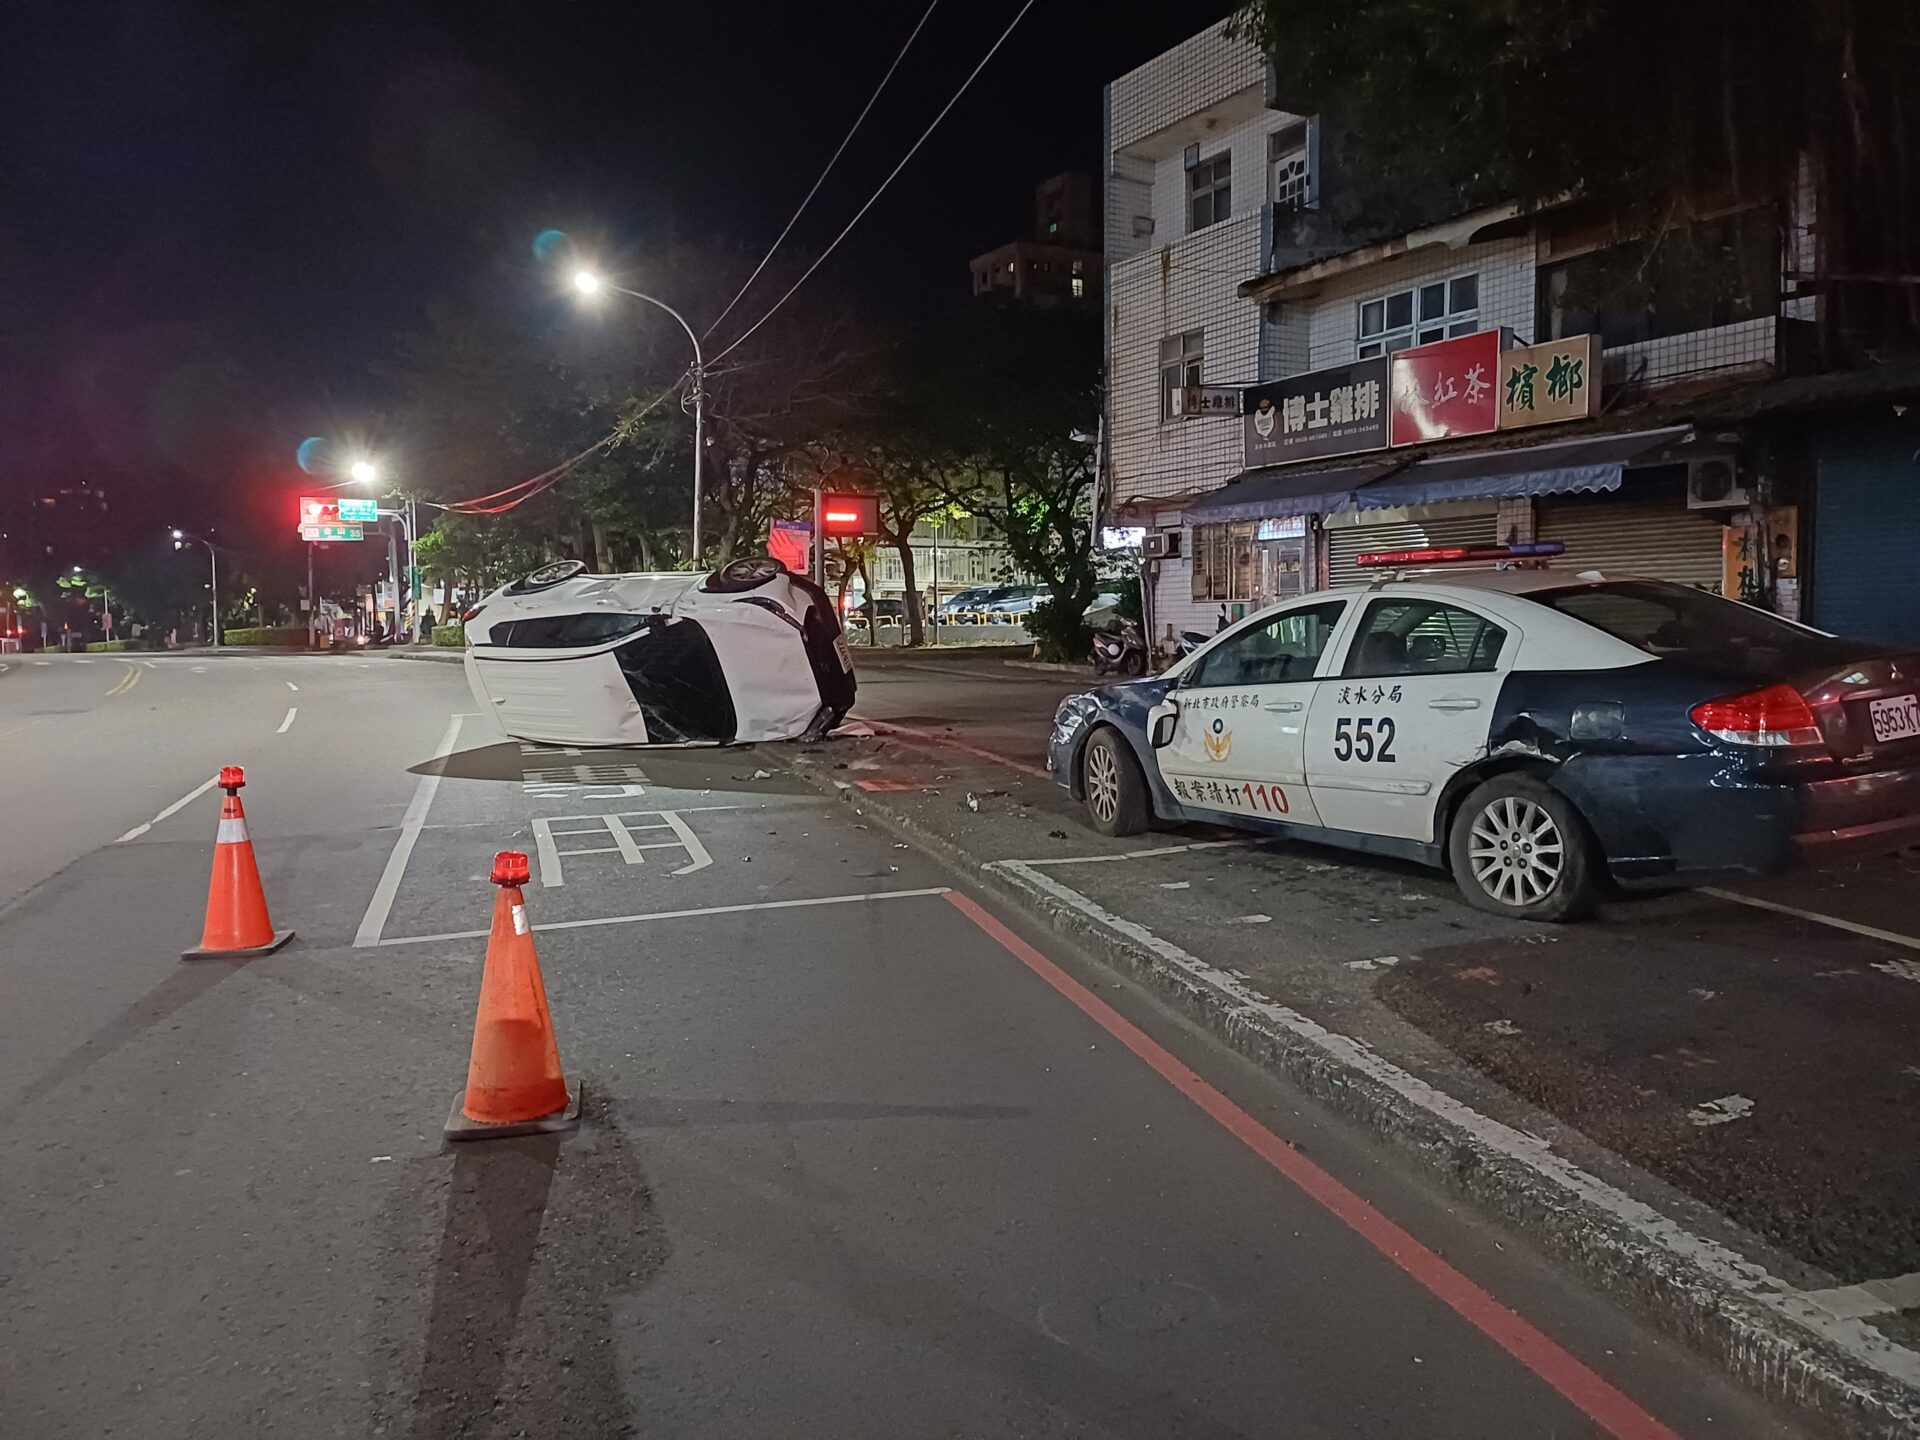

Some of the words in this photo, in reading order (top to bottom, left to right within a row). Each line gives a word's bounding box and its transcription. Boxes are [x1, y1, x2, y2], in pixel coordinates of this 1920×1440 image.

[1506, 353, 1584, 412] 檳榔
[1282, 380, 1380, 434] 博士雞排
[1183, 694, 1260, 711] 新北市政府警察局
[1337, 684, 1402, 705] 淡水分局
[1334, 717, 1396, 763] 552
